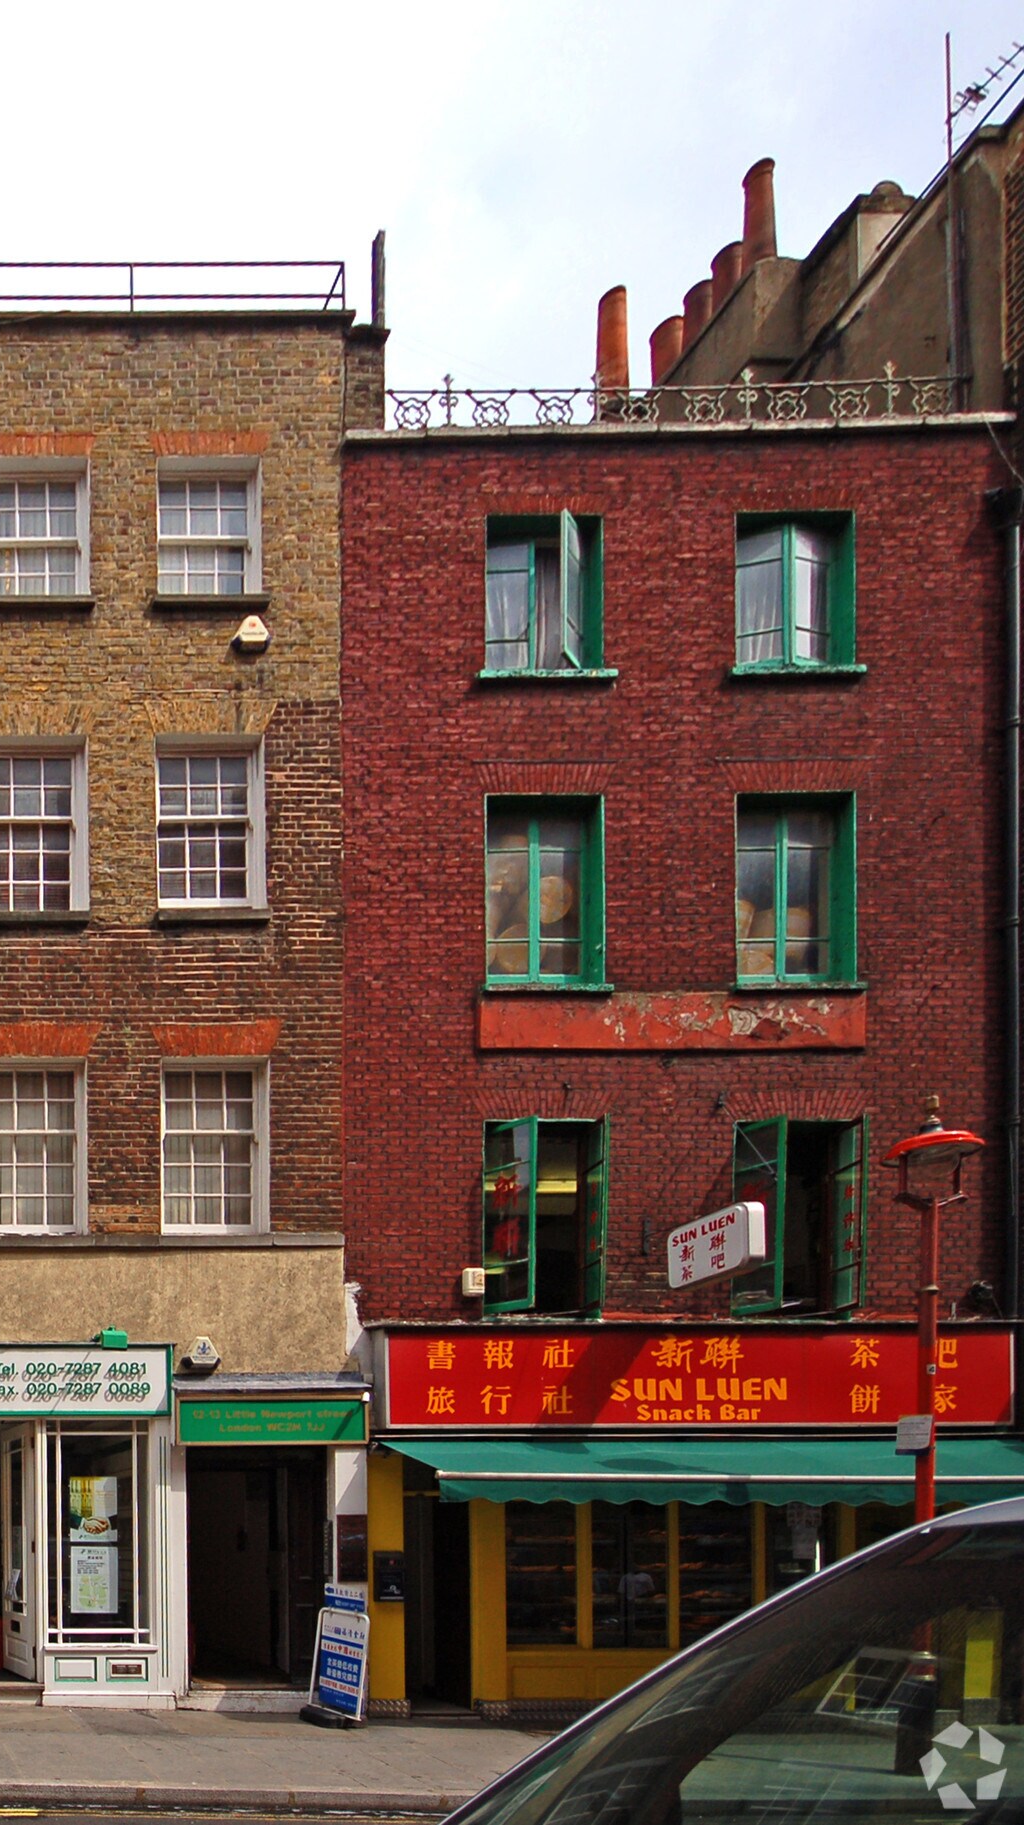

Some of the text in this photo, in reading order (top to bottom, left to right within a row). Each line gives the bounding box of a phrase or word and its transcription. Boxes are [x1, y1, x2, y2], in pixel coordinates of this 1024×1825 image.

[672, 1213, 735, 1257] SUN LUEN
[427, 1340, 574, 1370] 書報社
[651, 1335, 744, 1374] 新聯
[26, 1362, 102, 1376] 020-7287
[108, 1362, 148, 1375] 4081
[26, 1383, 102, 1396] 020-7287
[108, 1383, 152, 1396] 0089
[426, 1385, 573, 1415] 旅行社
[610, 1378, 787, 1402] SUN LUEN
[226, 1410, 257, 1418] Little
[261, 1410, 312, 1421] Newport
[636, 1404, 761, 1422] Snack Bar
[219, 1423, 262, 1432] London
